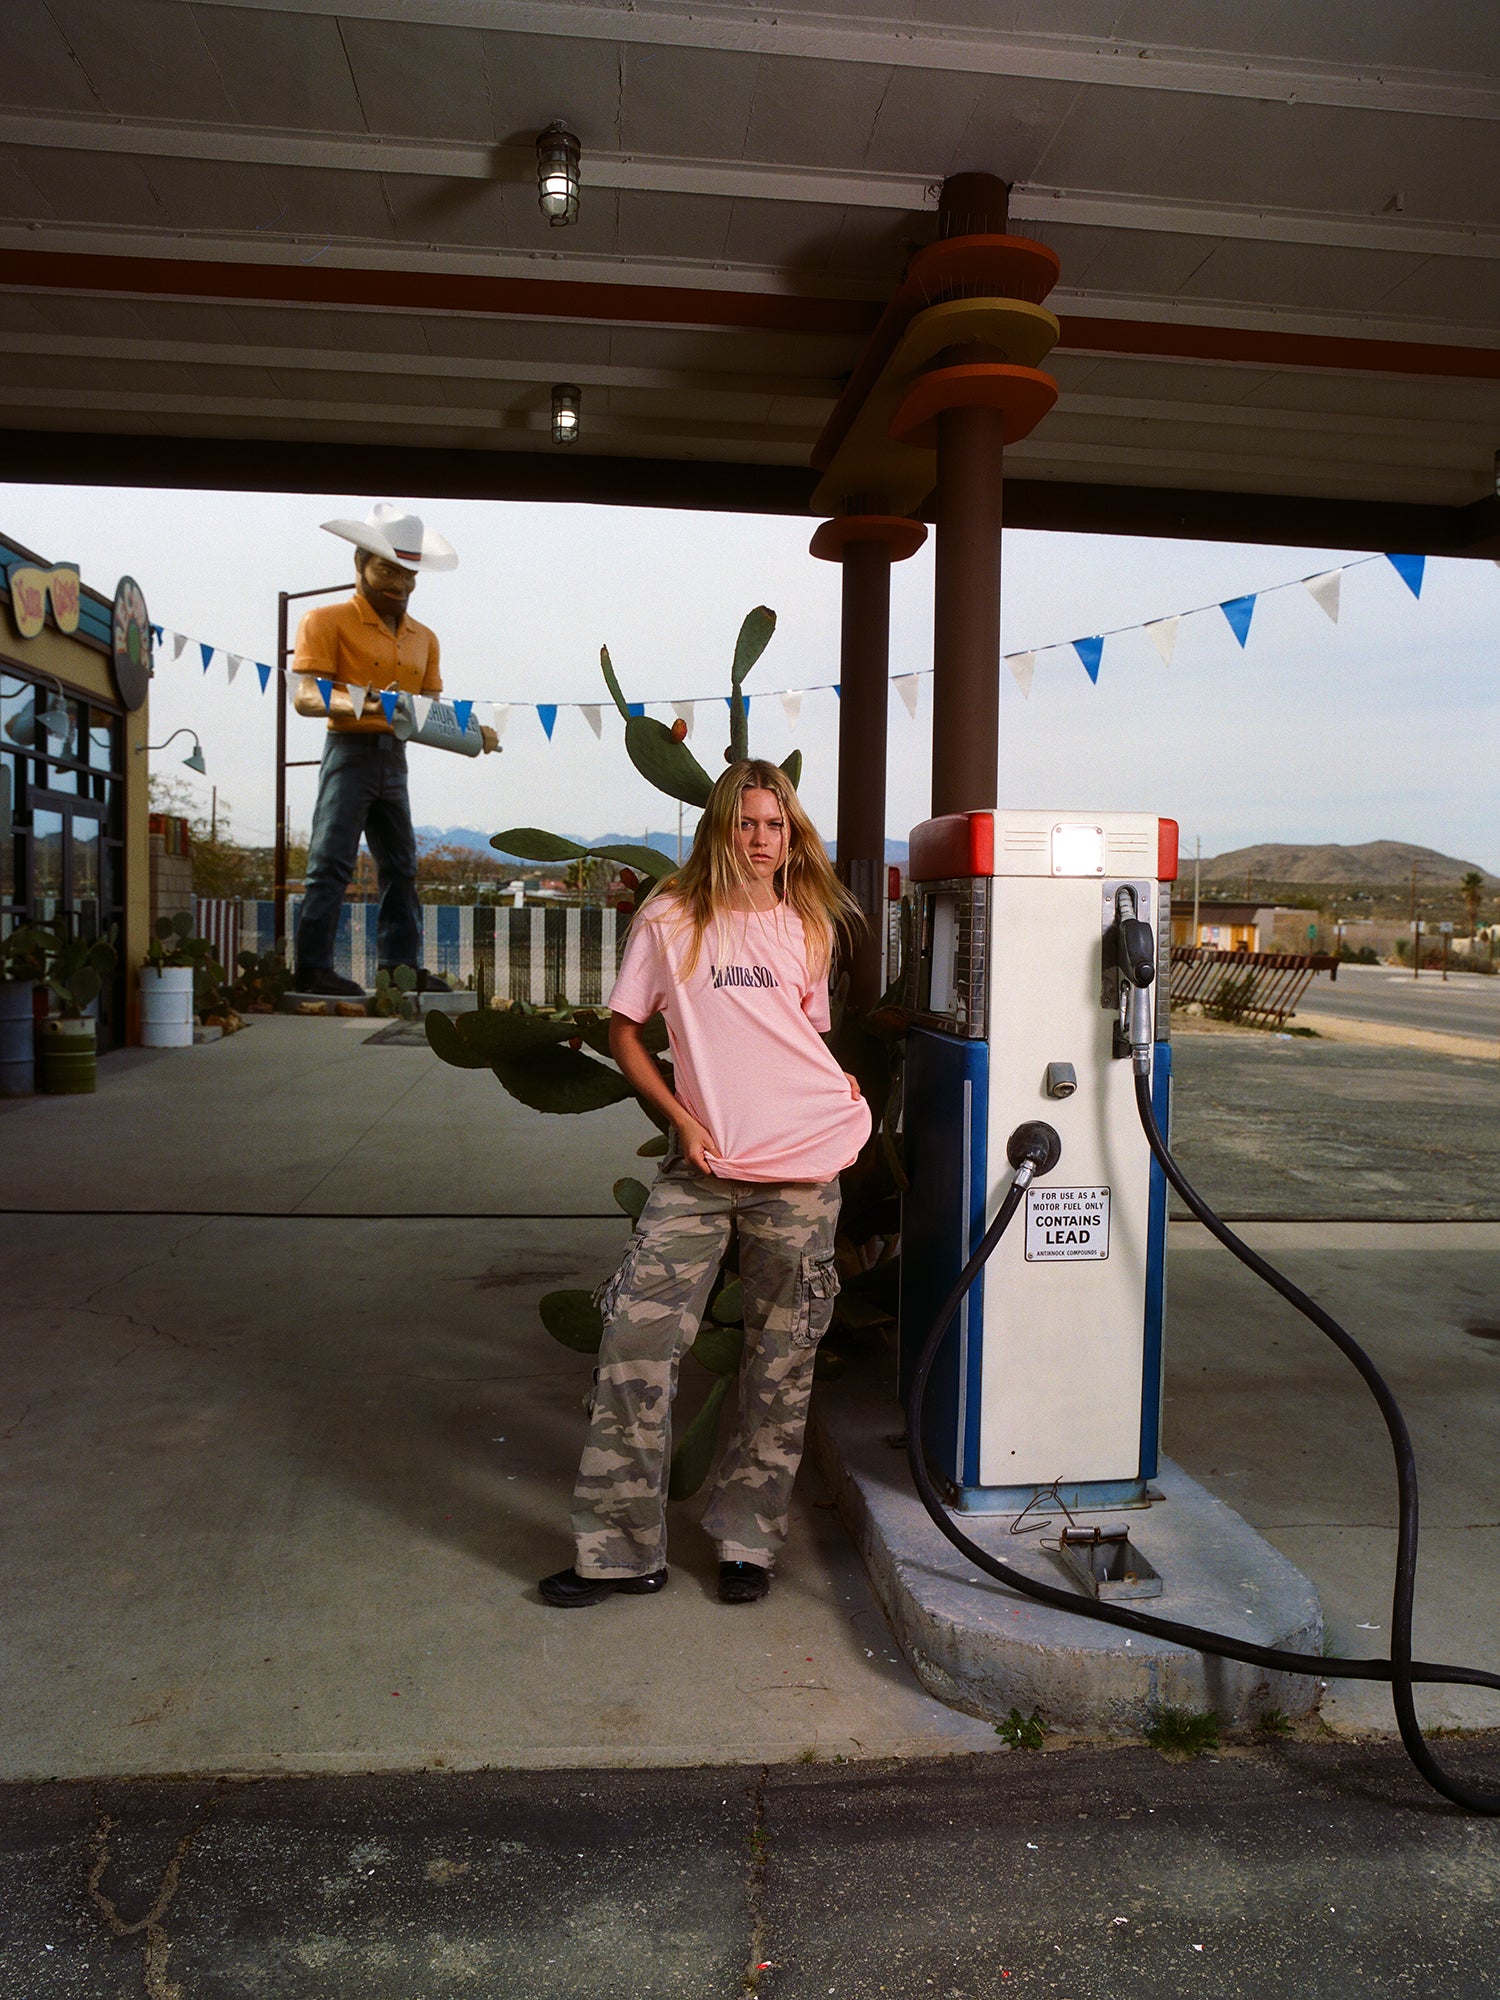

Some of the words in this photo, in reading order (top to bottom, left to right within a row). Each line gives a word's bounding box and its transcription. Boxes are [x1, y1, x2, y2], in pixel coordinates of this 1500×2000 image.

[1060, 1192, 1074, 1200] USE
[1033, 1203, 1060, 1211] MOTOR
[1063, 1202, 1081, 1210] FUEL
[1085, 1202, 1104, 1210] ONLY
[1035, 1215, 1101, 1227] CONTAINS
[1046, 1230, 1090, 1244] LEAD
